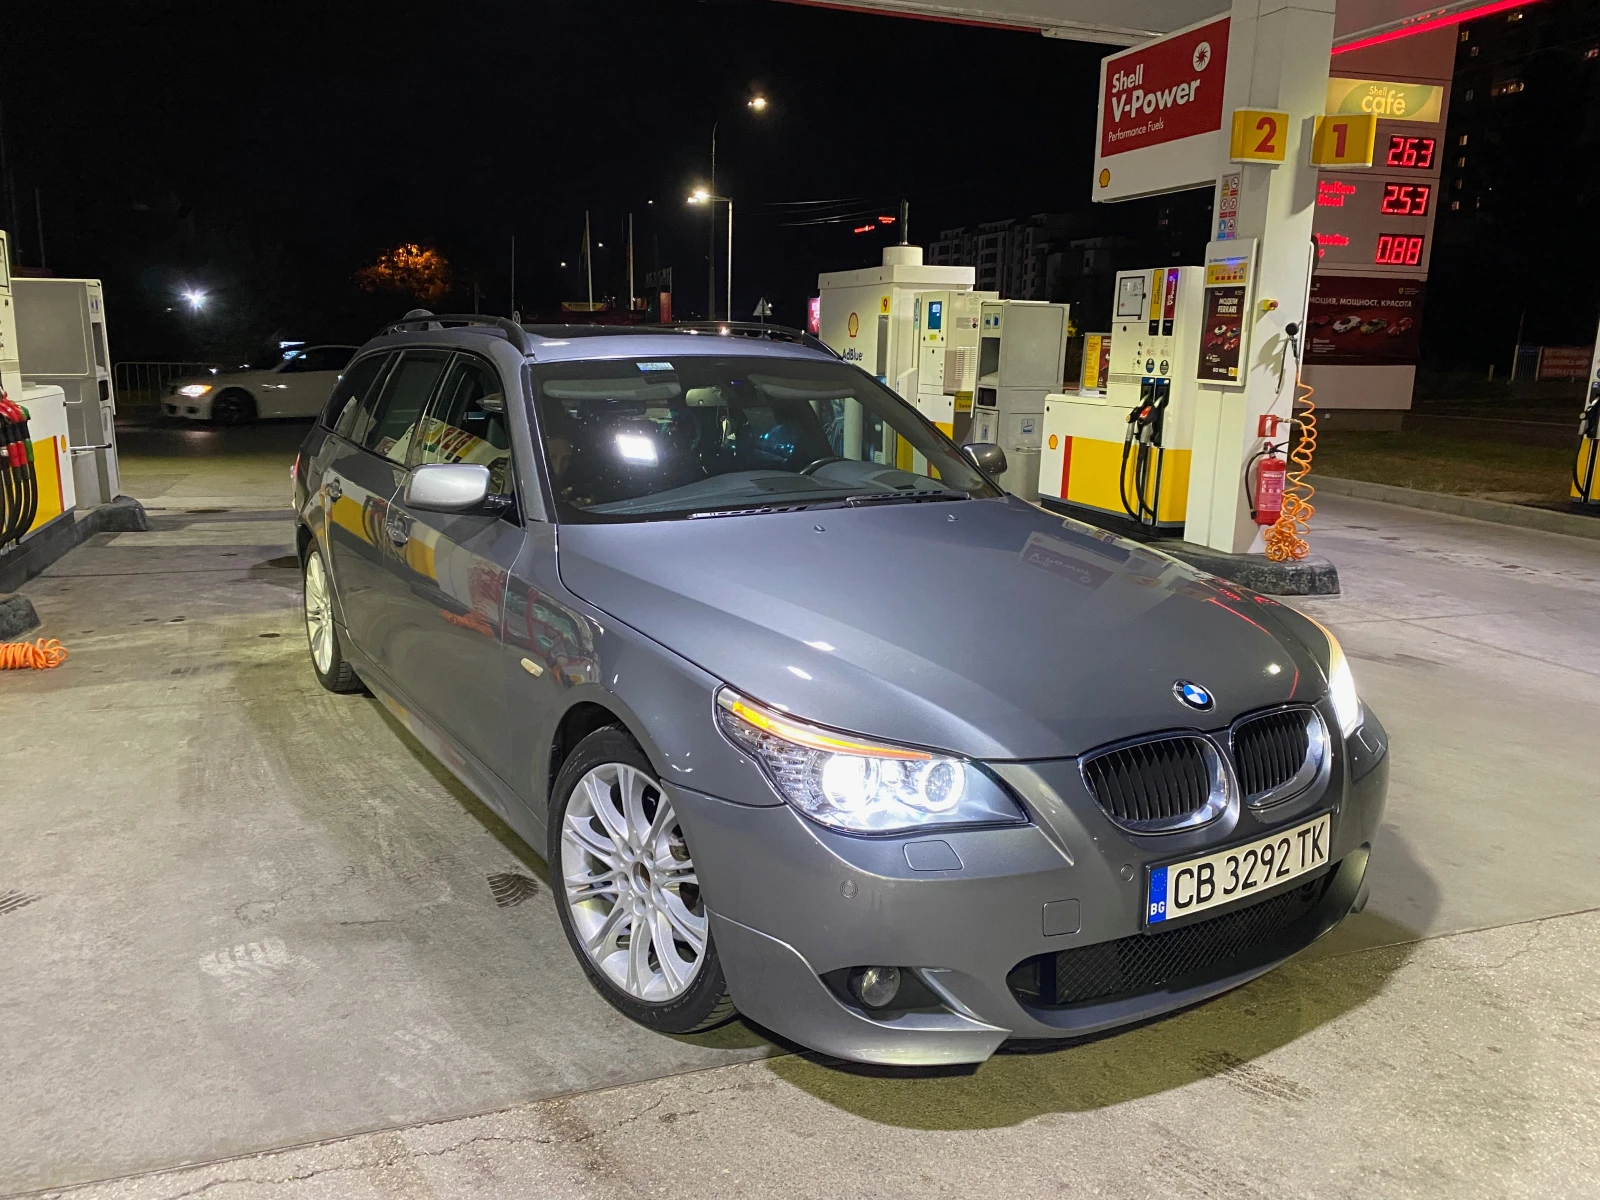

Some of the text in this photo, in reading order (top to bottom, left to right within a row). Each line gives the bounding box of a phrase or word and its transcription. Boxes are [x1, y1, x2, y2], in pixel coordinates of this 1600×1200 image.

[1112, 63, 1144, 94] Shell
[1369, 85, 1388, 96] Shell
[1111, 79, 1201, 123] V-Power
[1361, 90, 1406, 115] café
[1108, 116, 1164, 143] Performance Fuels
[1254, 116, 1277, 153] 2
[1332, 123, 1348, 158] 1
[1381, 185, 1429, 214] 2.53
[883, 298, 888, 312] 9
[1309, 297, 1338, 305] МОЦИЯ,
[842, 347, 863, 361] AdBlue
[1174, 821, 1325, 909] CB 3292 TK
[1150, 901, 1165, 916] BG
